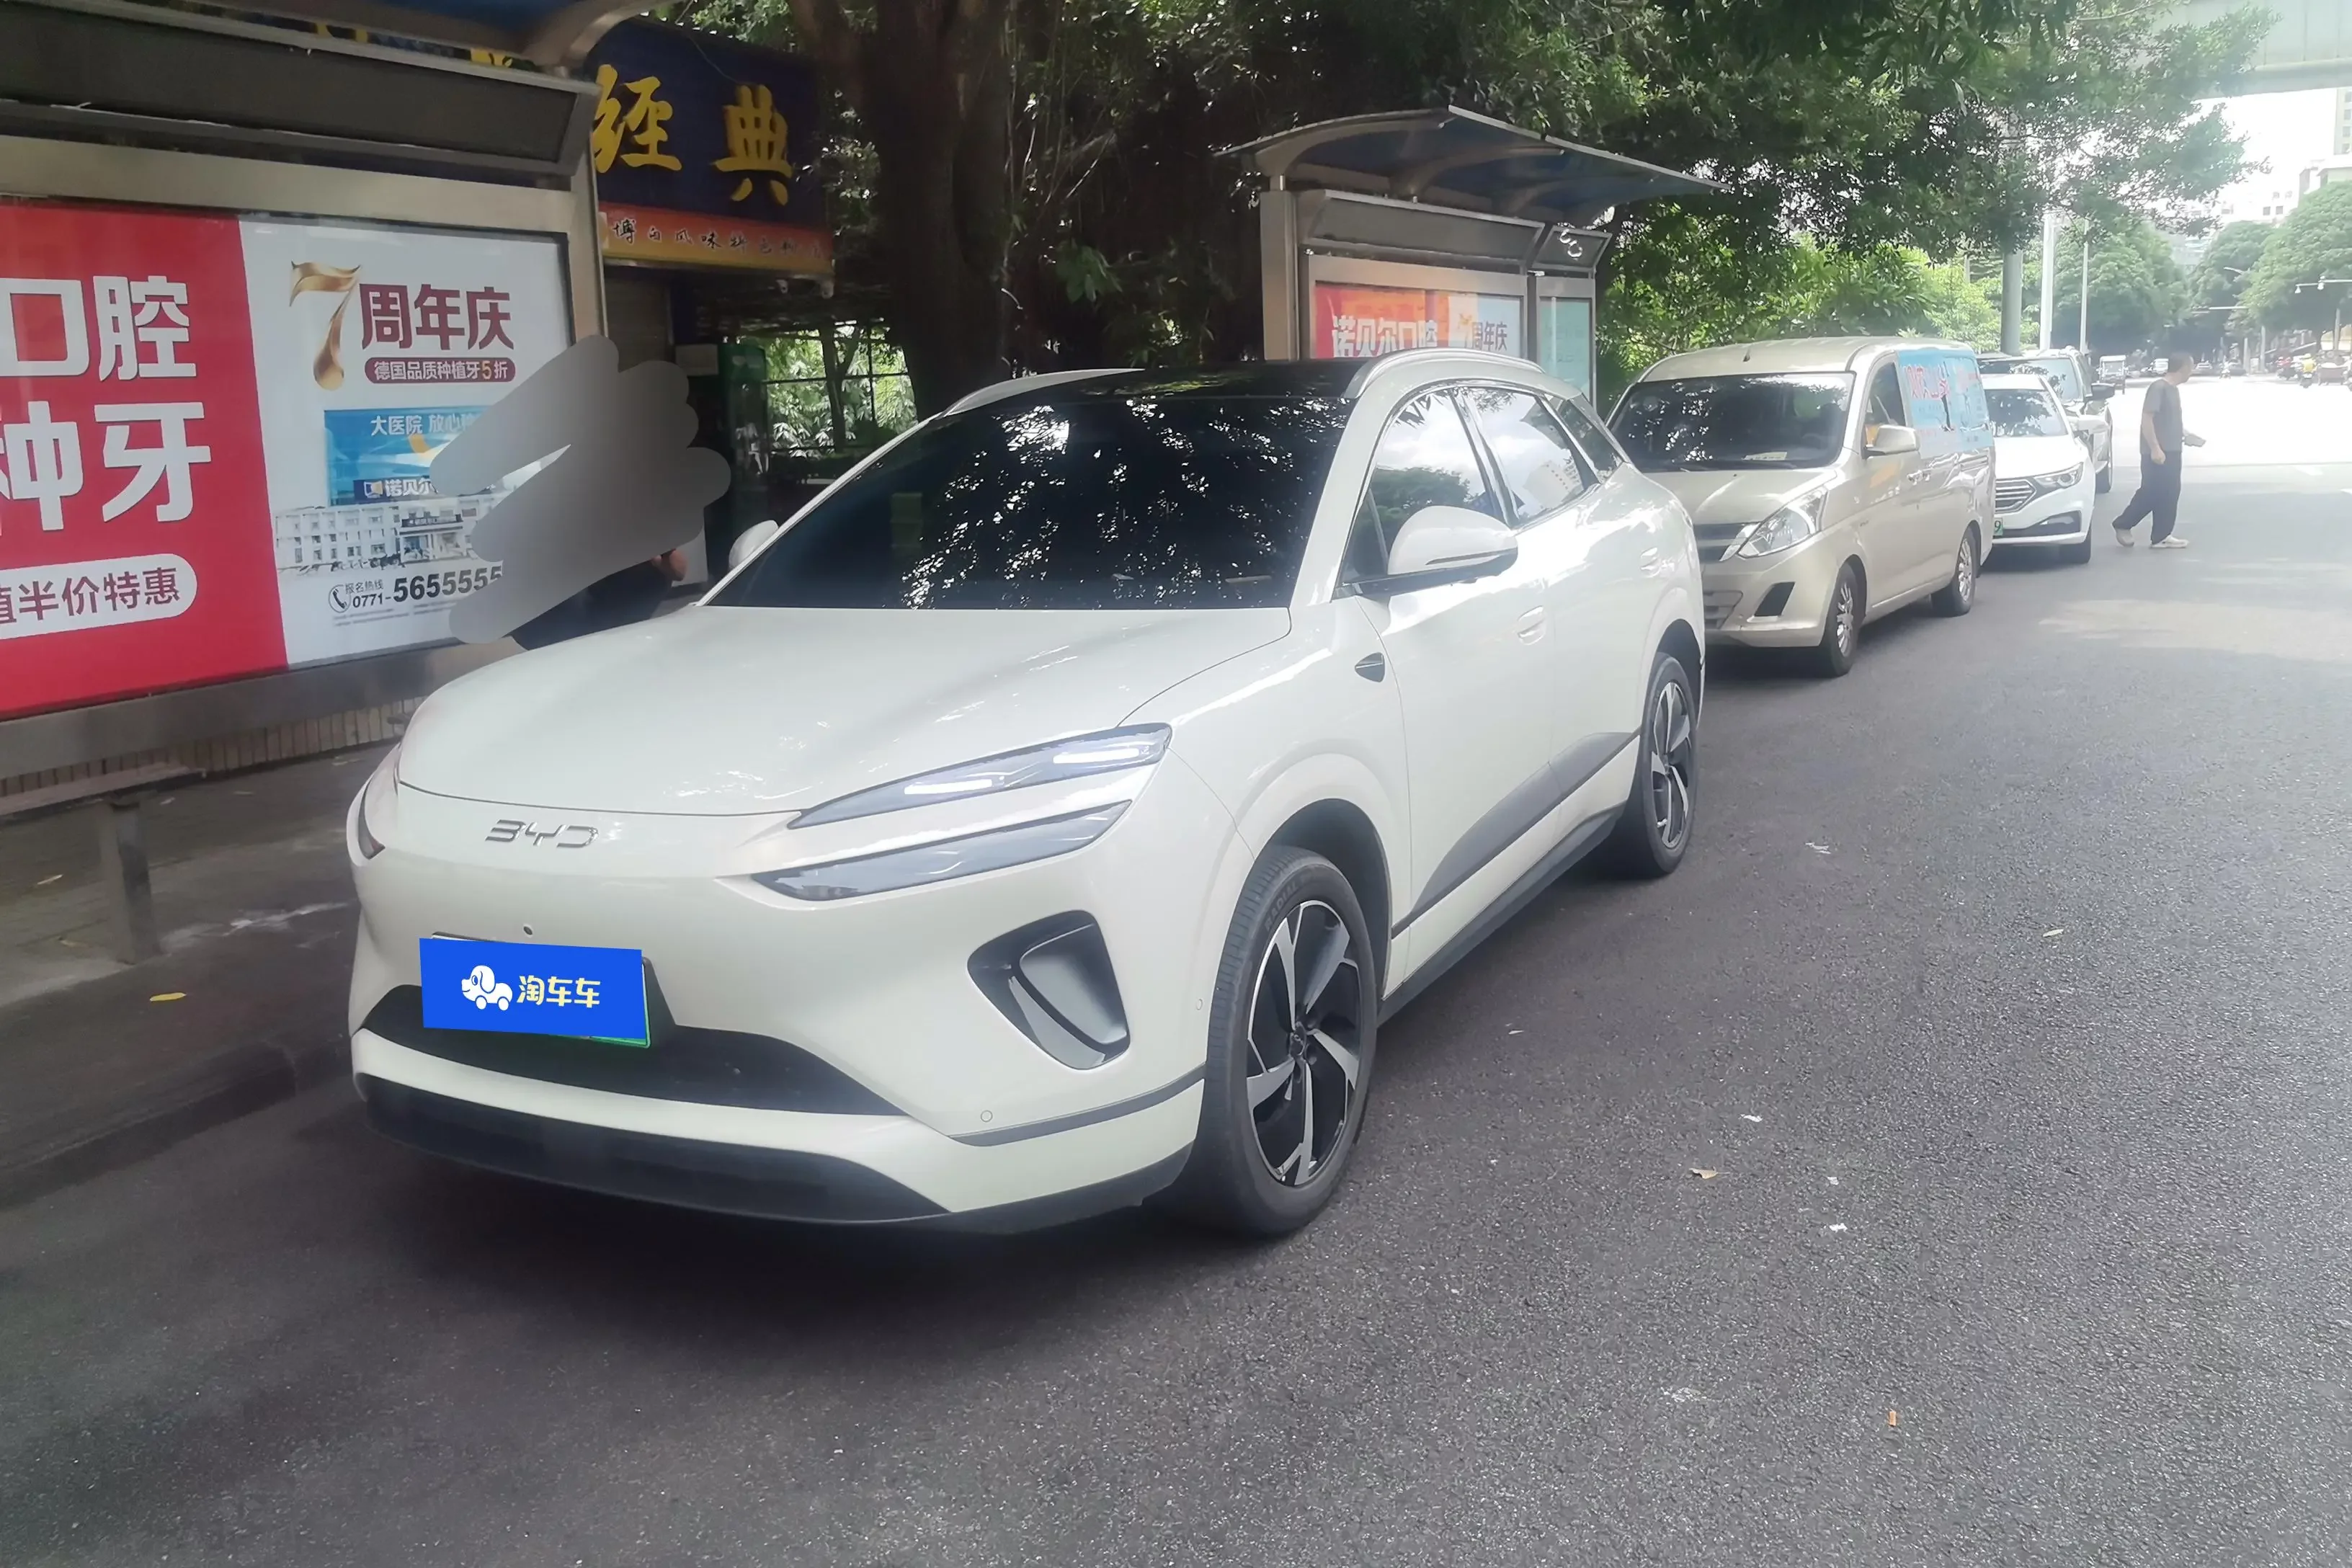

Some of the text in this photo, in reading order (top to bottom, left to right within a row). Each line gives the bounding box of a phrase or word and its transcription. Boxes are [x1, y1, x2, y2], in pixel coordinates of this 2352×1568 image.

[0, 276, 197, 381] 口腔
[1332, 315, 1438, 357] 诺贝尔口腔
[374, 360, 508, 381] 德国品质种植牙5折
[370, 415, 423, 436] 大医院
[486, 819, 599, 848] BYD
